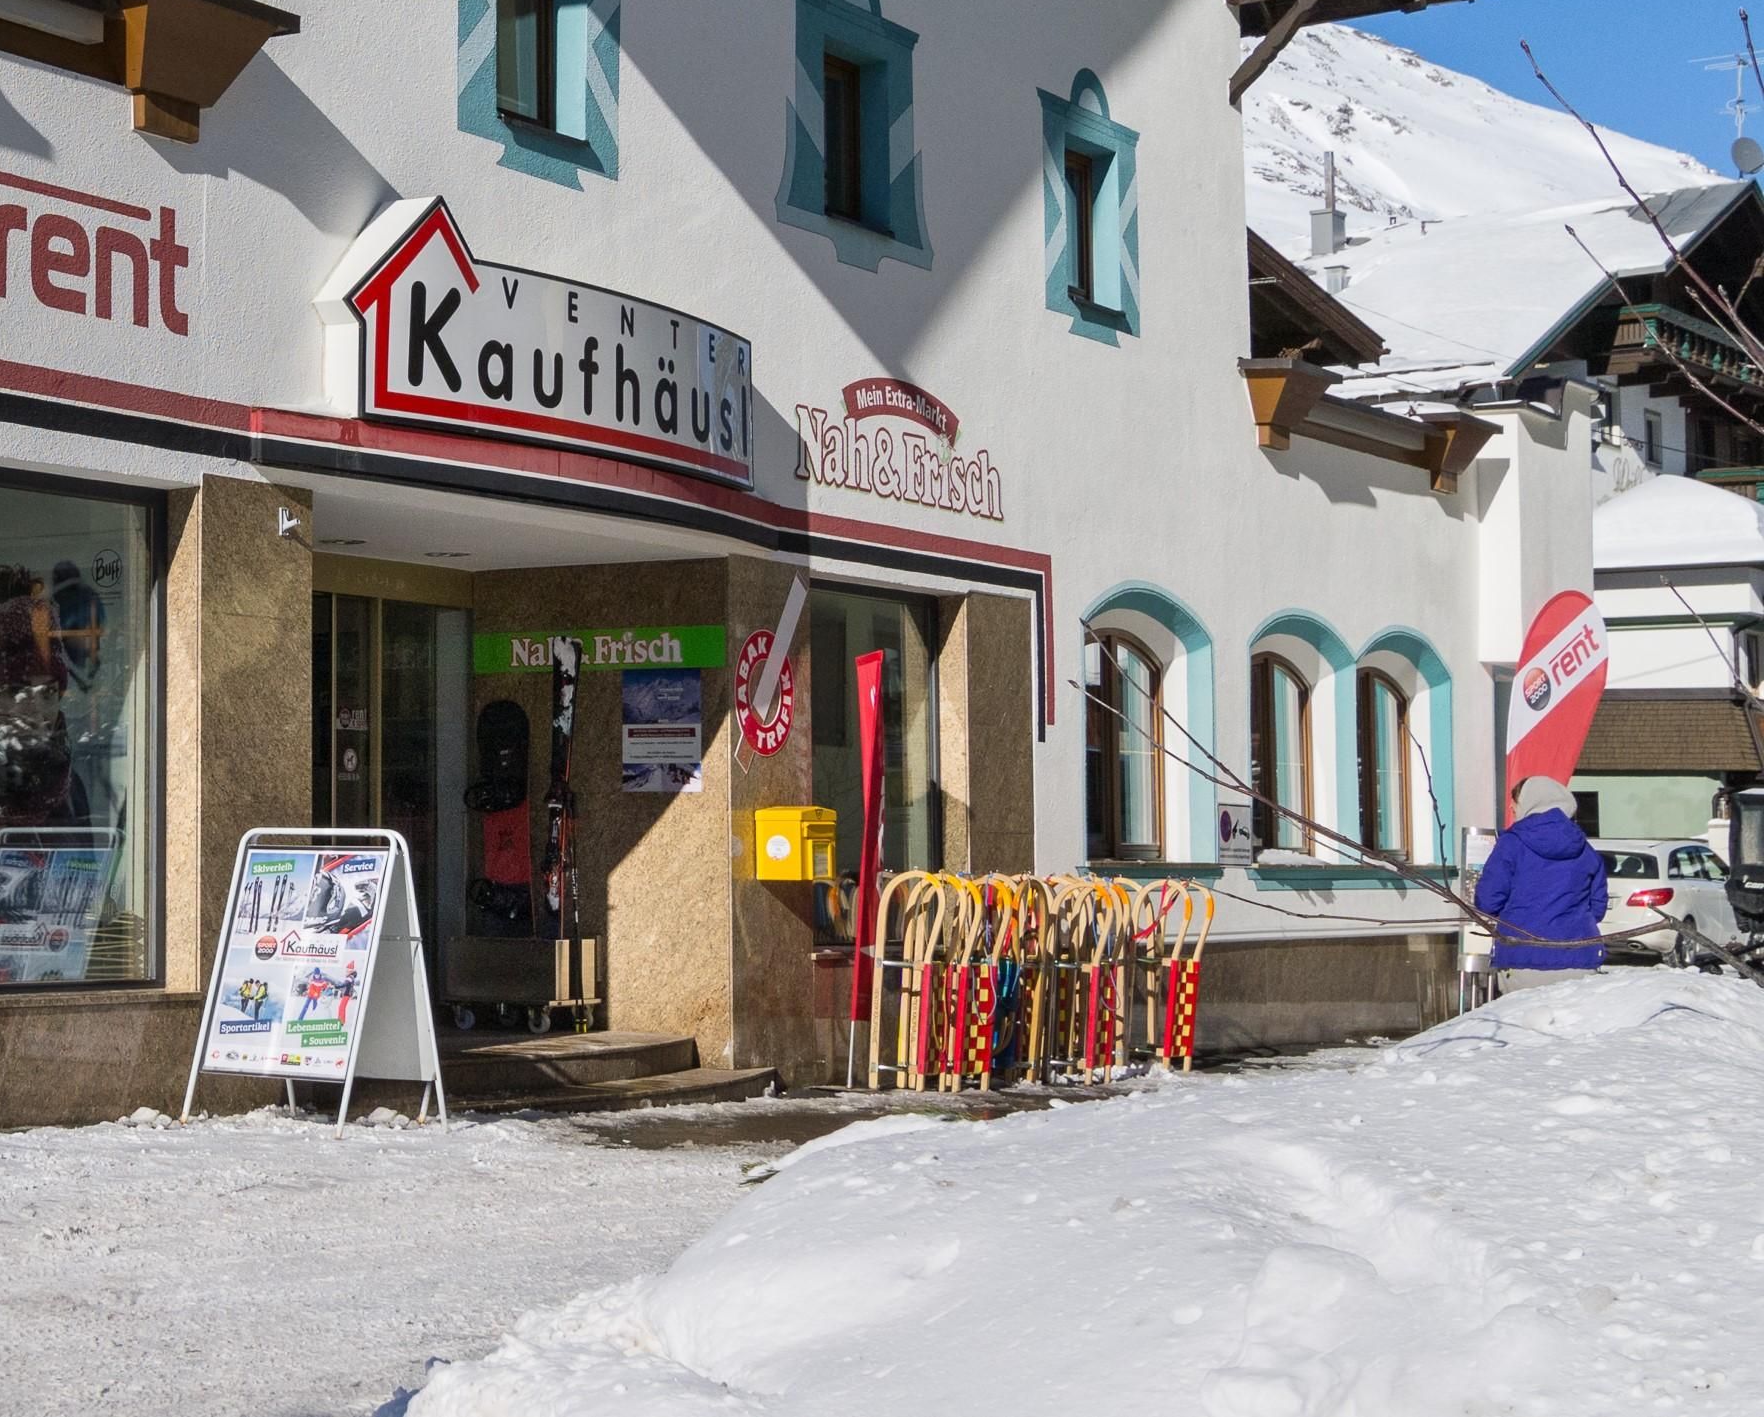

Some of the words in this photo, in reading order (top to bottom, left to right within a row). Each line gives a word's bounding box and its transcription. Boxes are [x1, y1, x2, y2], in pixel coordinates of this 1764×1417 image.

[502, 276, 745, 376] VENTER
[408, 280, 748, 457] Kaufhäusl
[856, 385, 883, 409] Mein
[885, 386, 947, 431] Extra-Markt
[594, 632, 684, 665] Frisch
[1552, 624, 1600, 686] rent
[738, 636, 768, 725] TABAK
[1525, 673, 1546, 697] SPORT
[1529, 683, 1548, 703] 2000
[756, 669, 792, 749] TRAFIK
[252, 862, 293, 874] Skiverleih
[344, 861, 374, 872] Service
[286, 940, 339, 954] Kaufhäusl
[220, 1022, 270, 1034] Sportartikel
[287, 1021, 341, 1033] Lebensmittel
[308, 1035, 345, 1046] Souvenir
